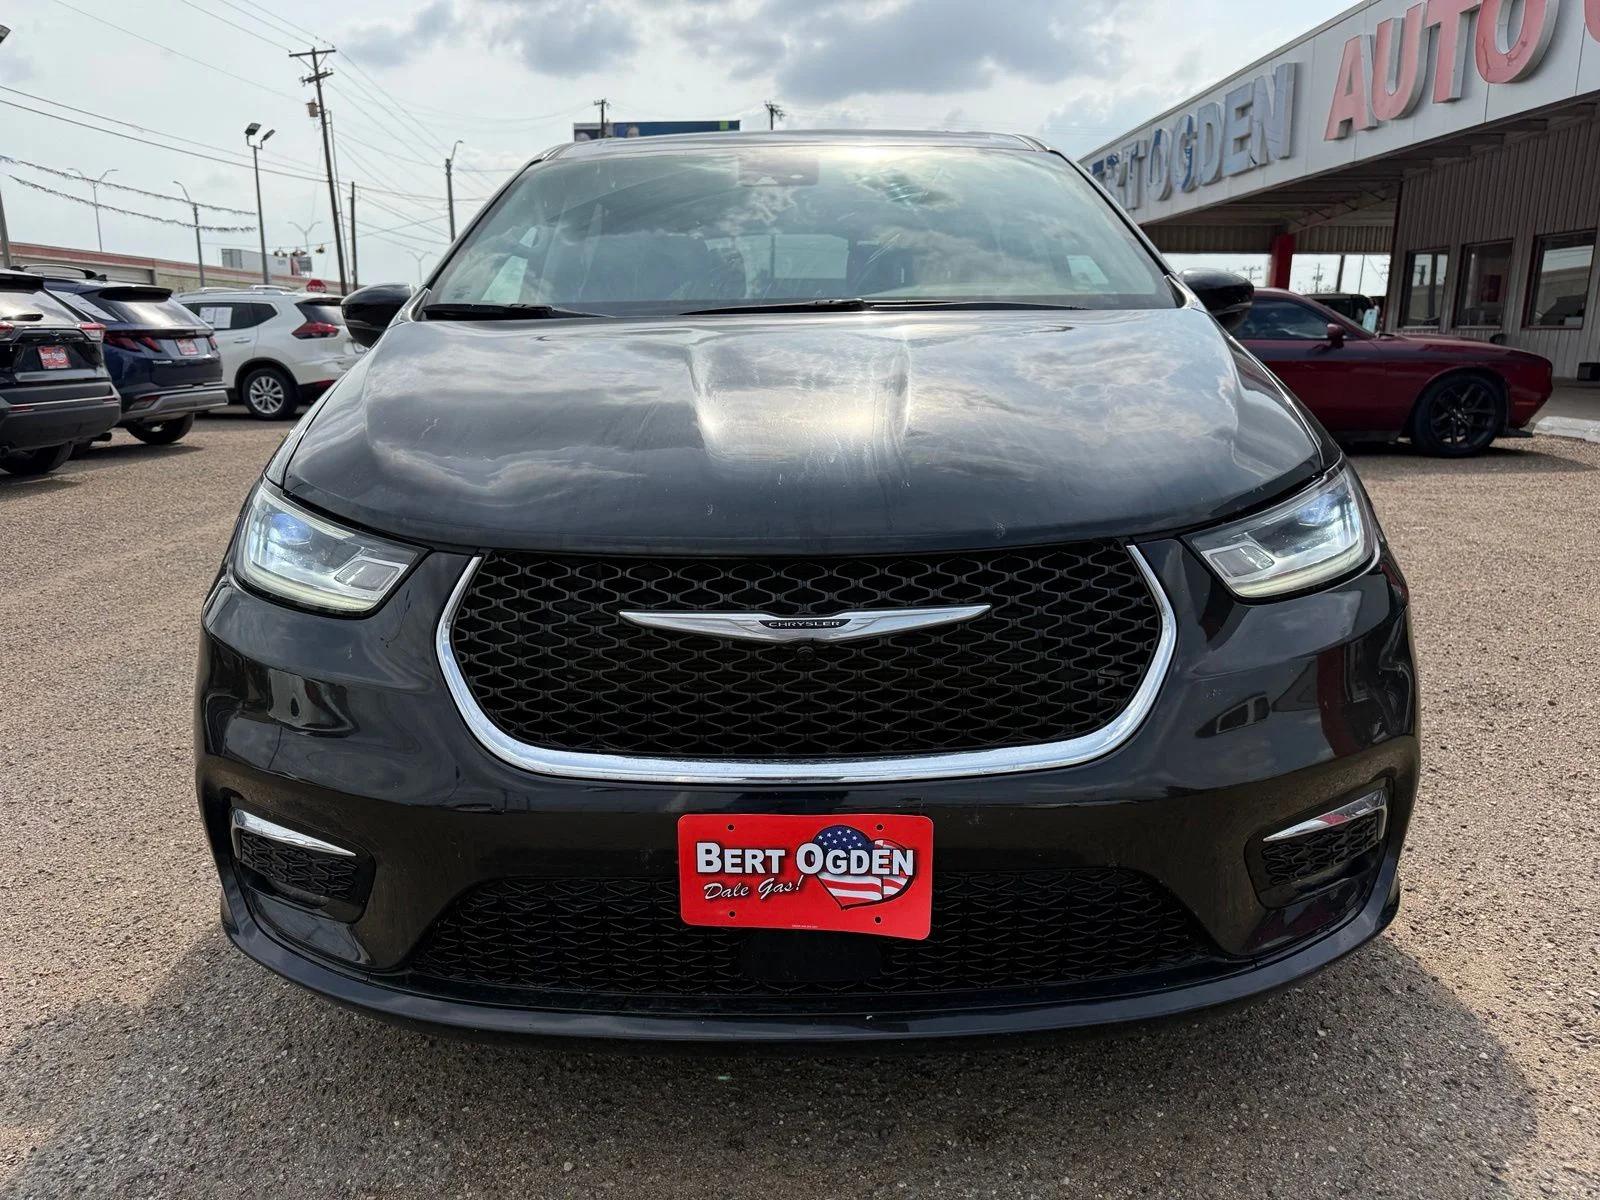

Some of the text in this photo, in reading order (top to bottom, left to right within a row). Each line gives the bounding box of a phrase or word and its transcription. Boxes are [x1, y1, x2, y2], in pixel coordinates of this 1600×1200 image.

[1146, 62, 1297, 202] OGDEN
[1324, 0, 1559, 141] AUTO
[696, 842, 914, 876] BERT OGDEN
[703, 874, 805, 900] Dale Gas!
